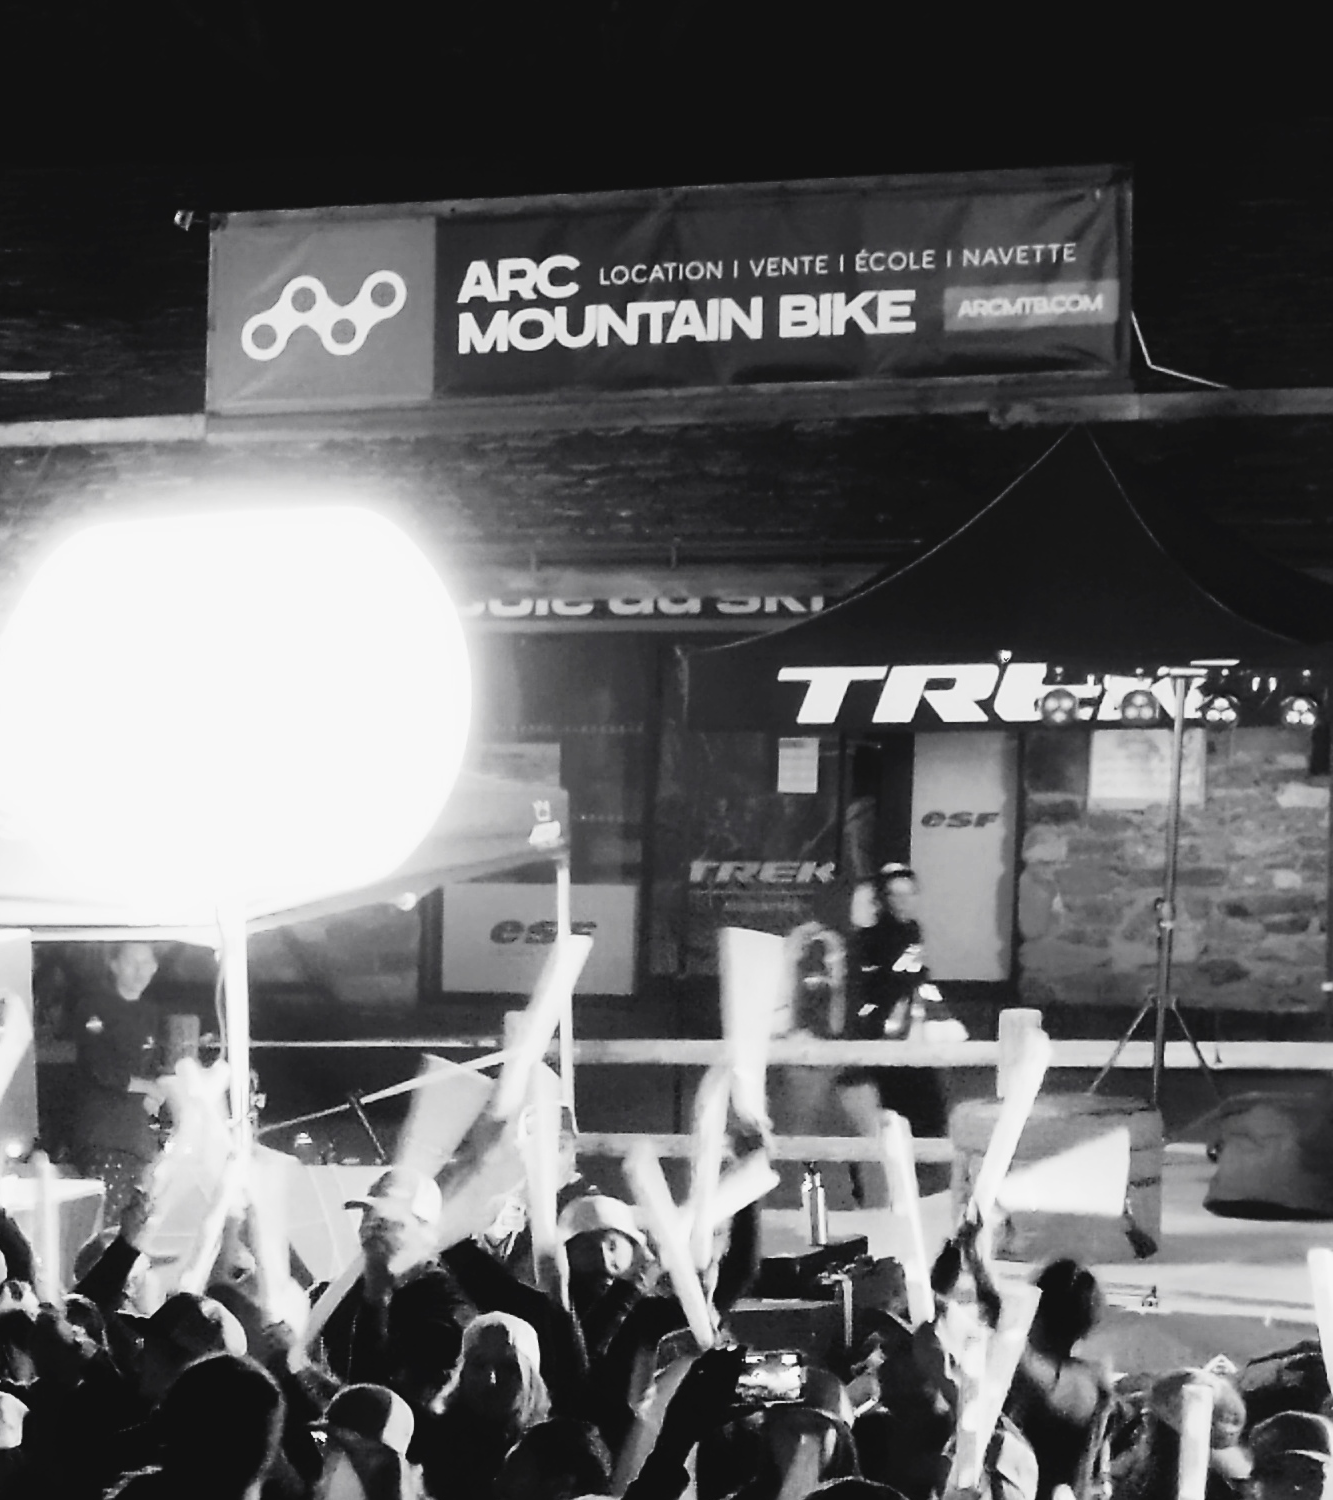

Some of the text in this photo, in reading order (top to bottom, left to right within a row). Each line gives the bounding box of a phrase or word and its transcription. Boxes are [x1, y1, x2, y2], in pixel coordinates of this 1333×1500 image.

[456, 254, 581, 303] ARC
[598, 242, 1077, 286] LOCATION VENTE ÉCOLE NAVETTE
[457, 289, 917, 354] MOUNTAIN BIKE
[689, 861, 837, 887] TREK
